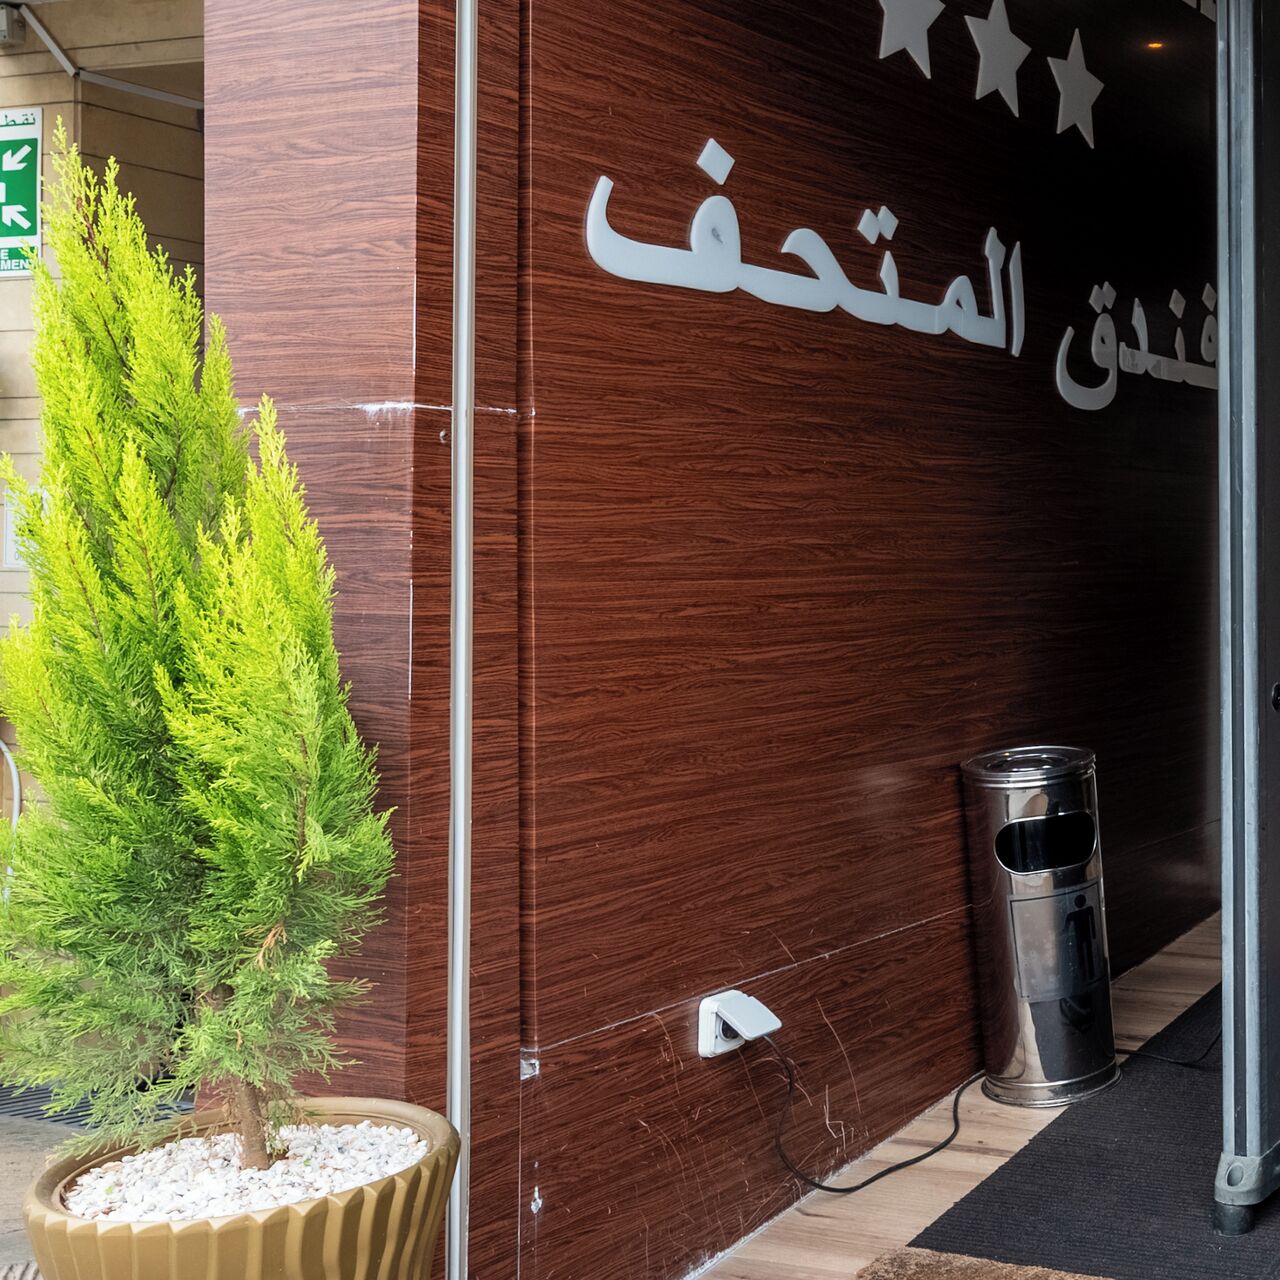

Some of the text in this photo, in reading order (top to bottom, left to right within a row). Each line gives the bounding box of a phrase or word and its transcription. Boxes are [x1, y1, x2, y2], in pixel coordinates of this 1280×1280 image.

[0, 113, 36, 127] نقط
[586, 137, 1218, 410] فندق المتحف
